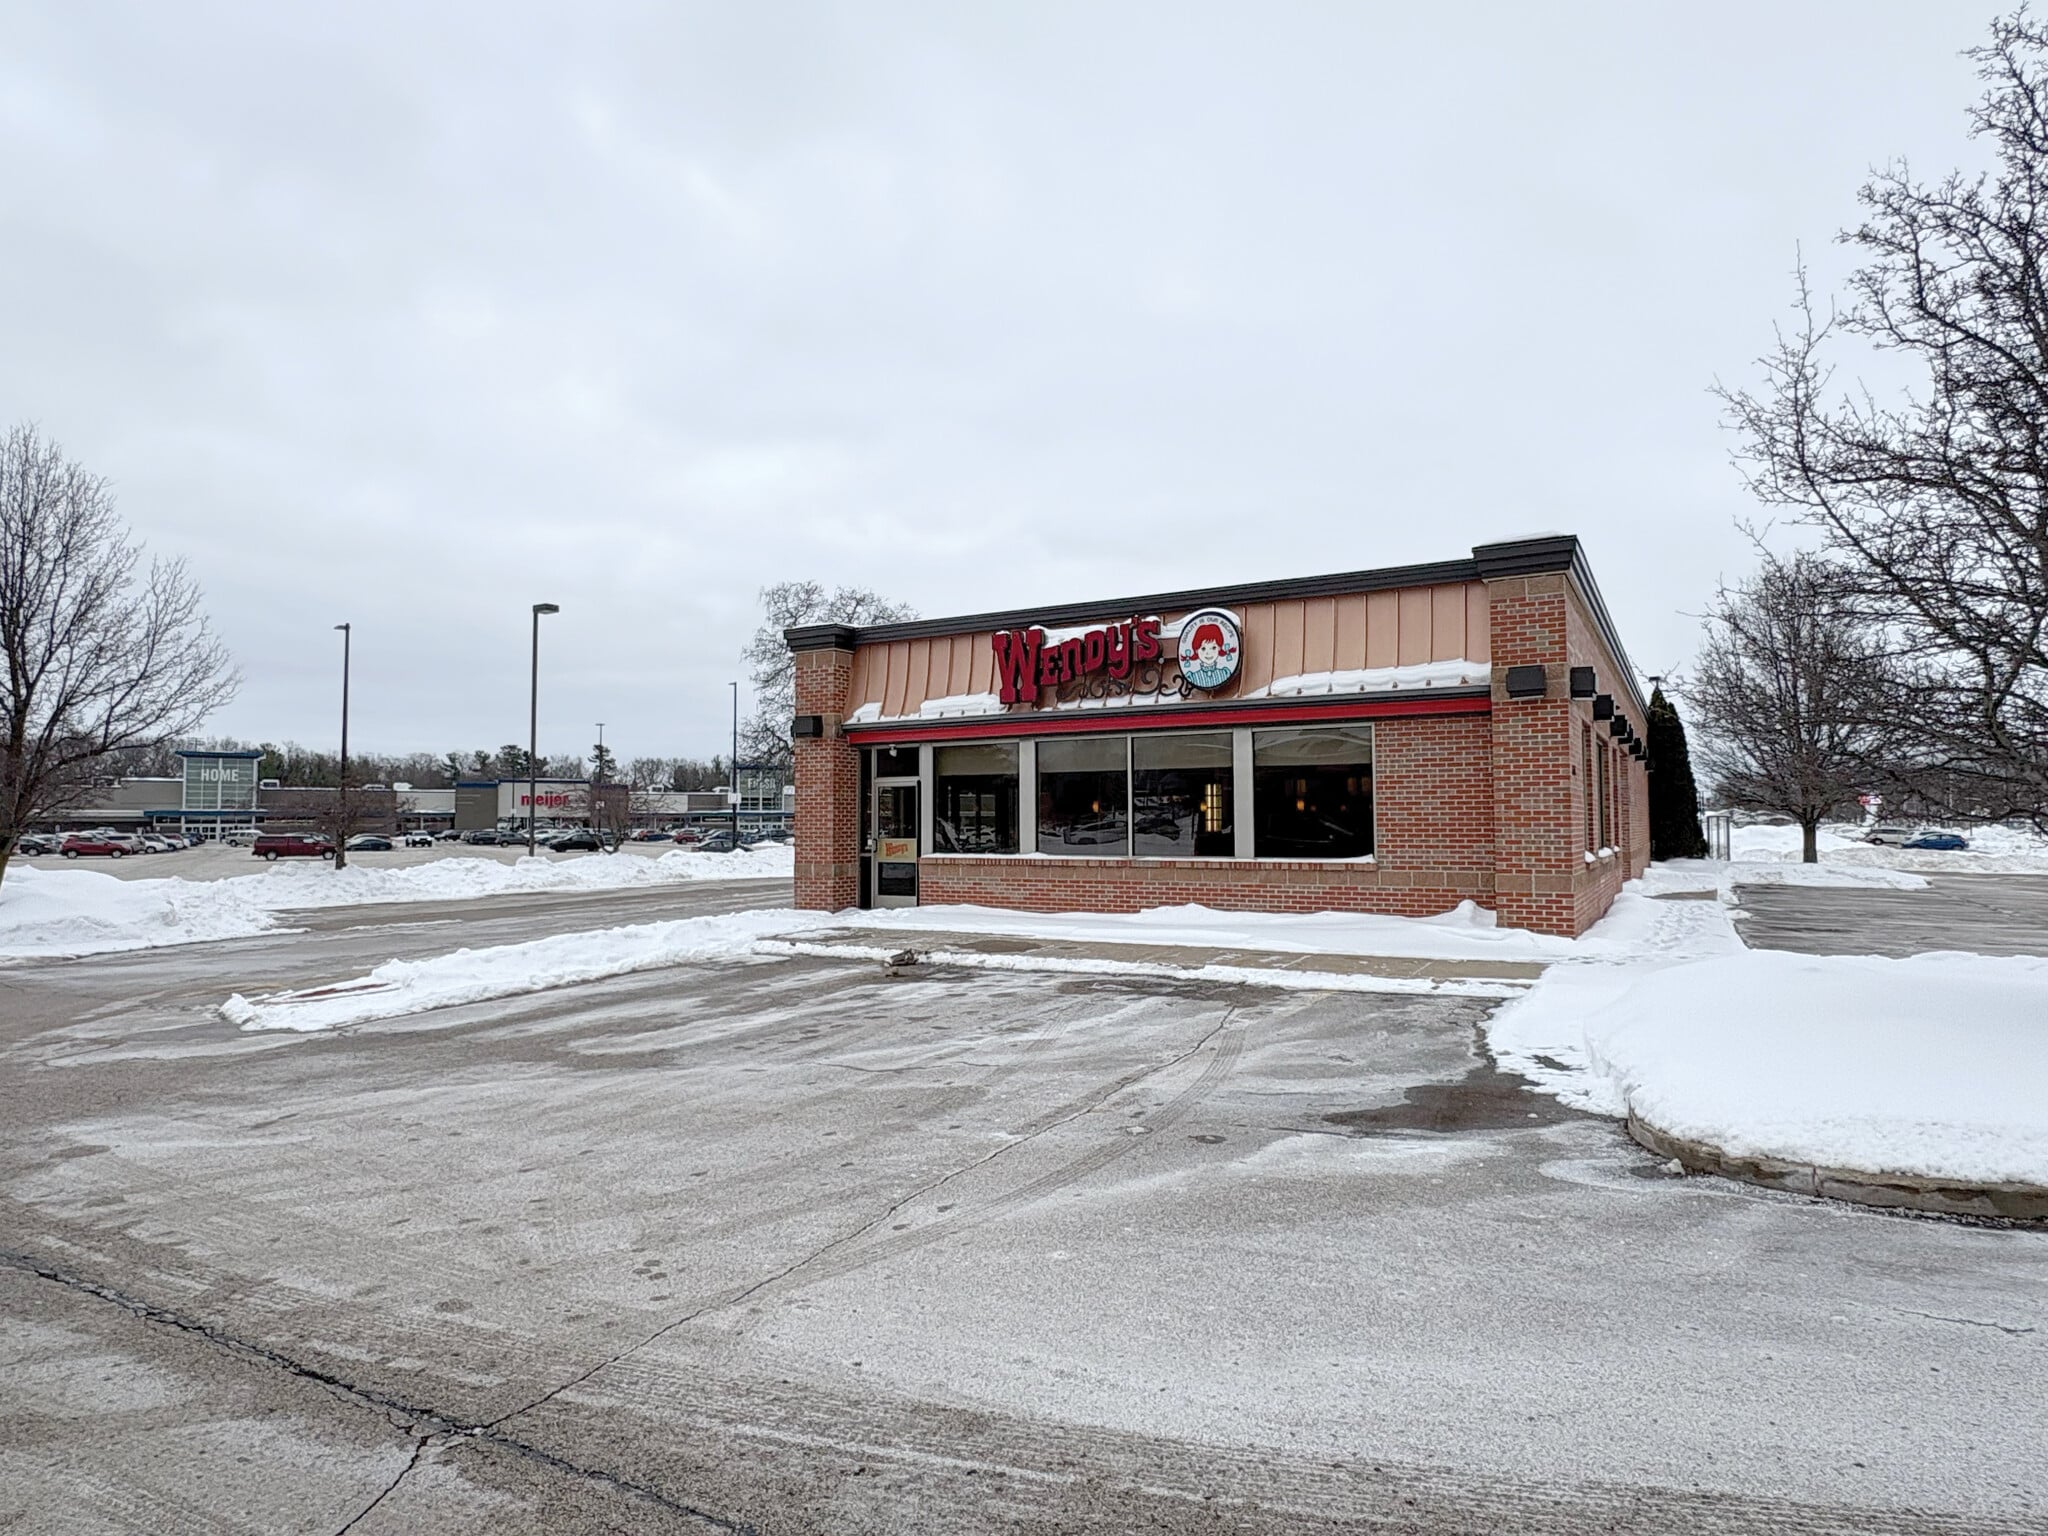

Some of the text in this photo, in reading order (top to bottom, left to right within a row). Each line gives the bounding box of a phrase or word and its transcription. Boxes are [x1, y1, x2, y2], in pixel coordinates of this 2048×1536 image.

[1182, 622, 1198, 644] QUALITY
[1219, 620, 1235, 638] RECIPE
[992, 615, 1162, 705] Wendy's
[201, 768, 239, 782] HOME
[521, 791, 569, 809] meijer
